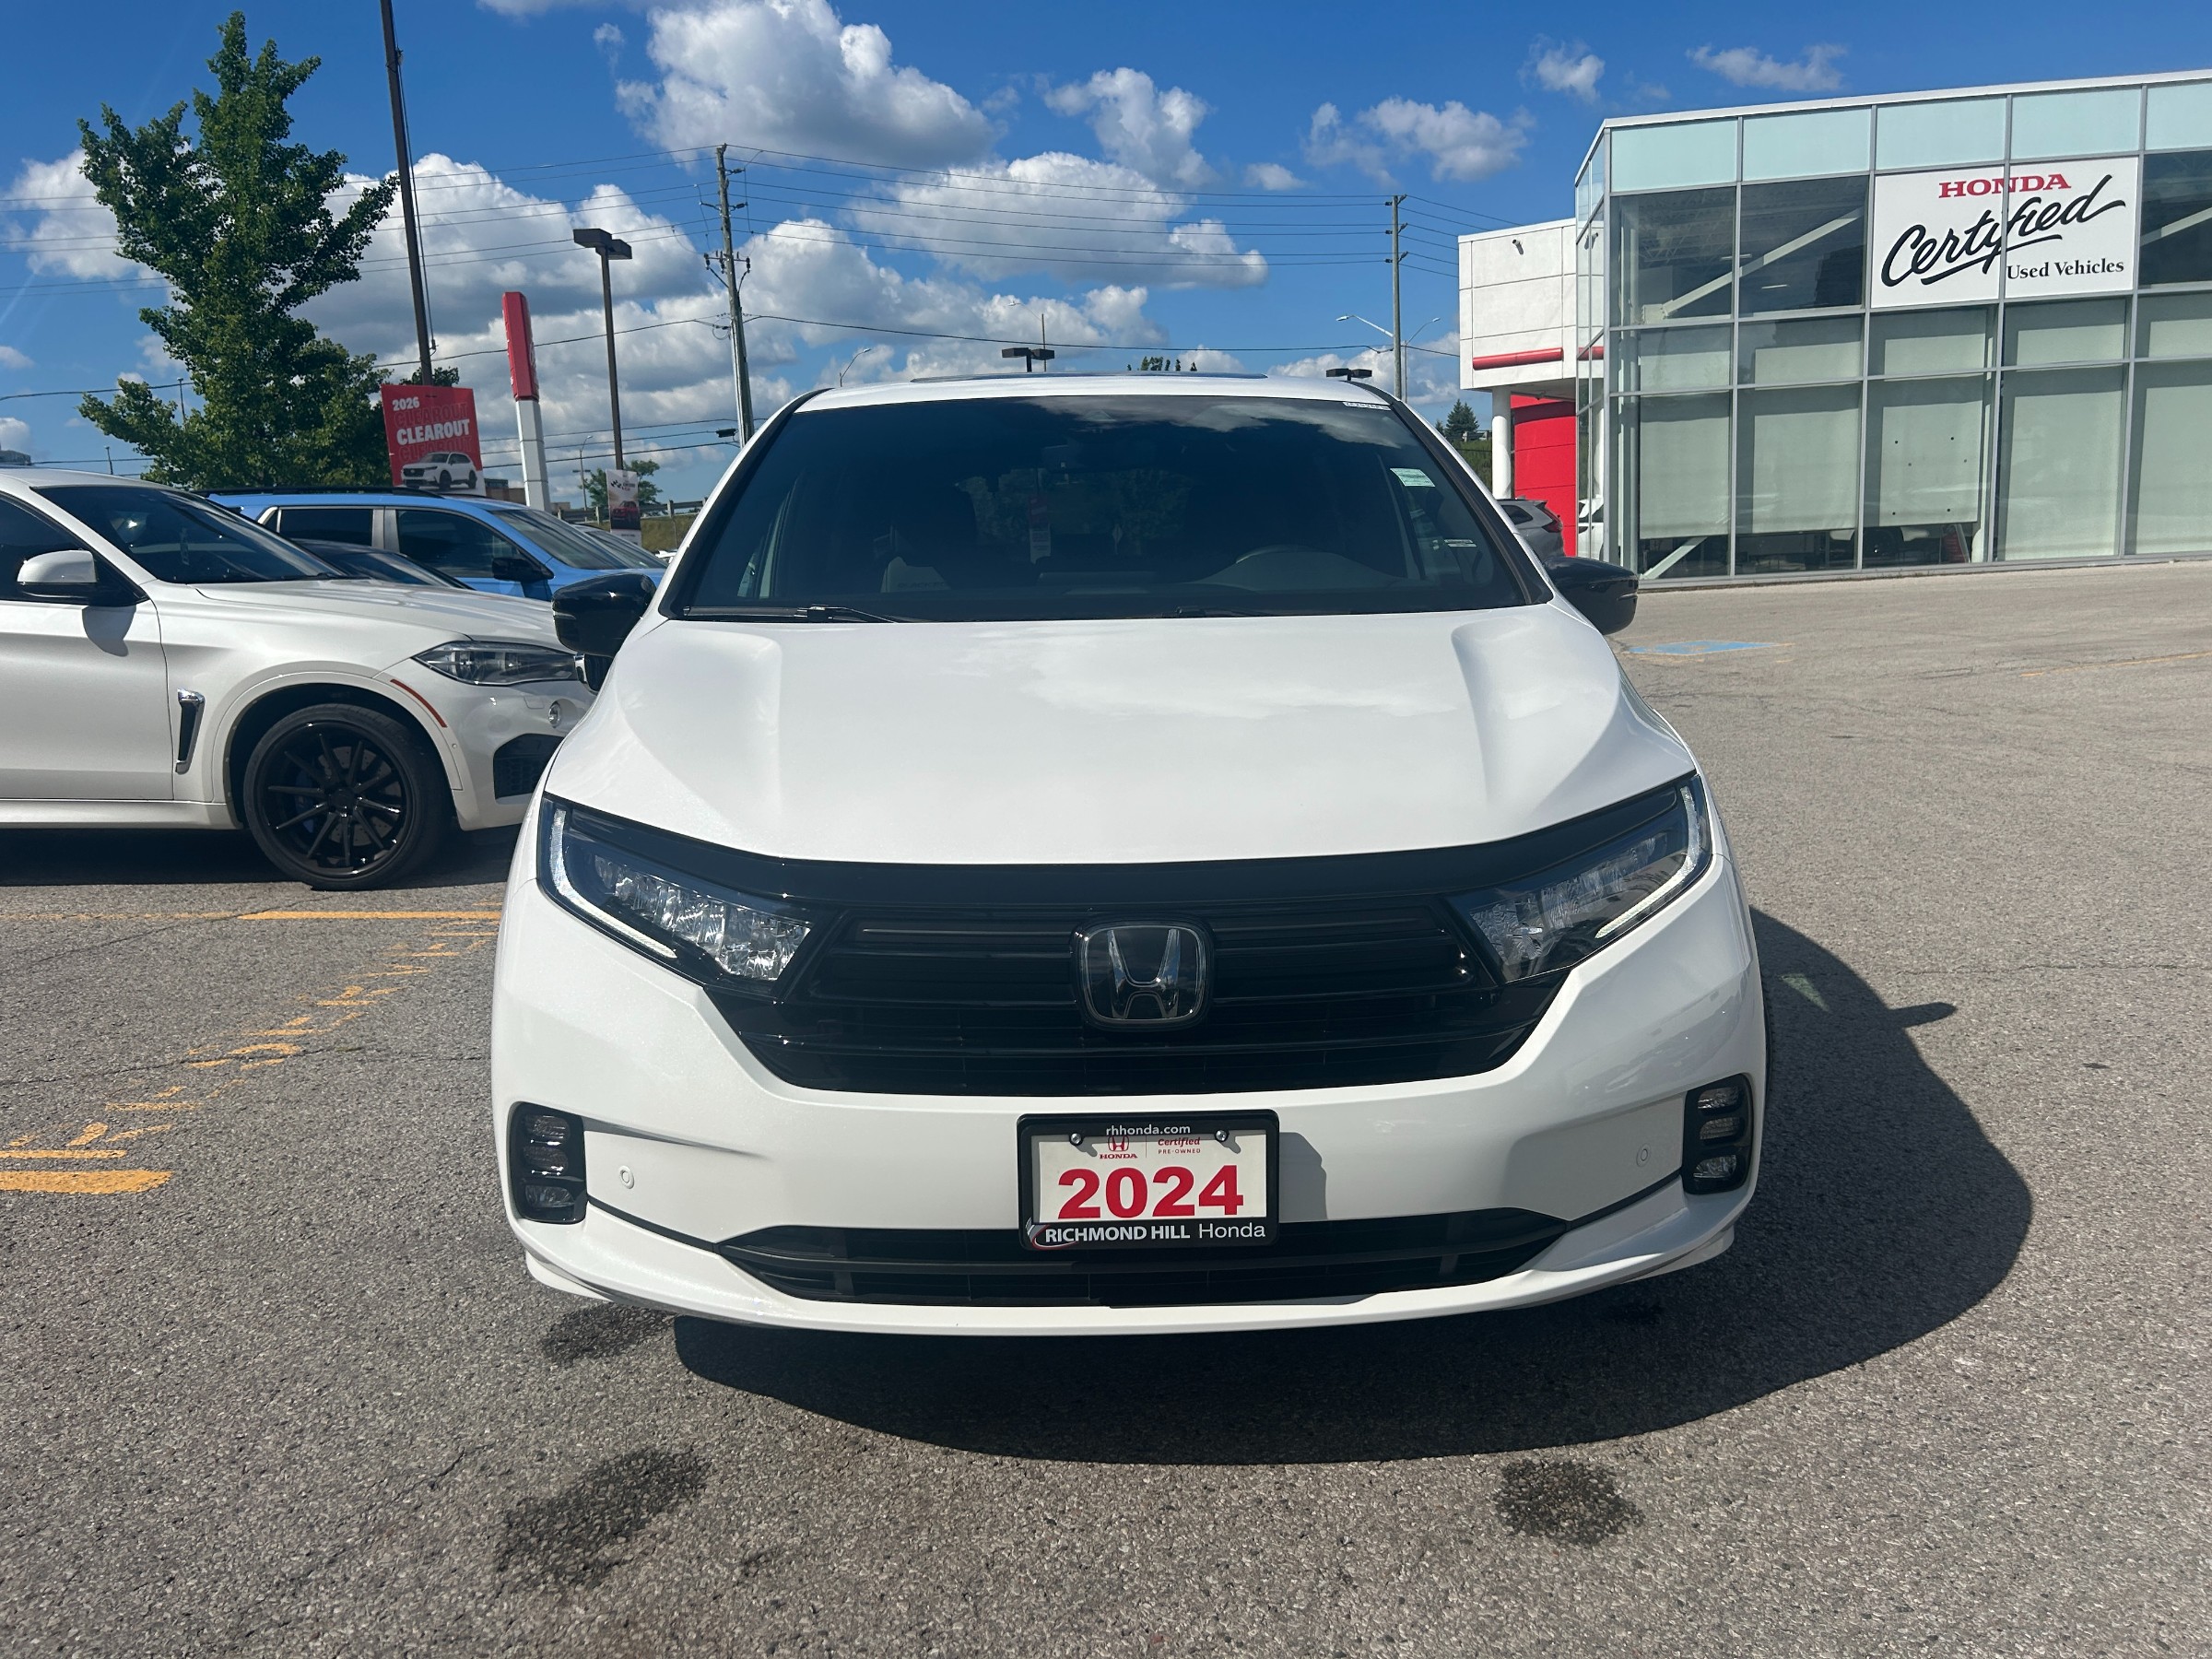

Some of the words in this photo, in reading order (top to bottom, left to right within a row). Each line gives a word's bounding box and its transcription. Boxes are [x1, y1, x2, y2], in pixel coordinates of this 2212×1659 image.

[1938, 173, 2072, 198] HONDA
[1881, 174, 2125, 286] Certified
[2006, 261, 2050, 279] Used
[2053, 258, 2124, 276] Vehicles
[392, 396, 420, 412] 2026
[396, 418, 470, 445] CLEAROUT
[1106, 1124, 1191, 1135] rhhonda.com
[1158, 1136, 1201, 1147] Certified
[1057, 1164, 1244, 1219] 2024
[1045, 1226, 1147, 1242] RICHMOND
[1151, 1225, 1191, 1240] HILL
[1198, 1222, 1266, 1239] Honda
